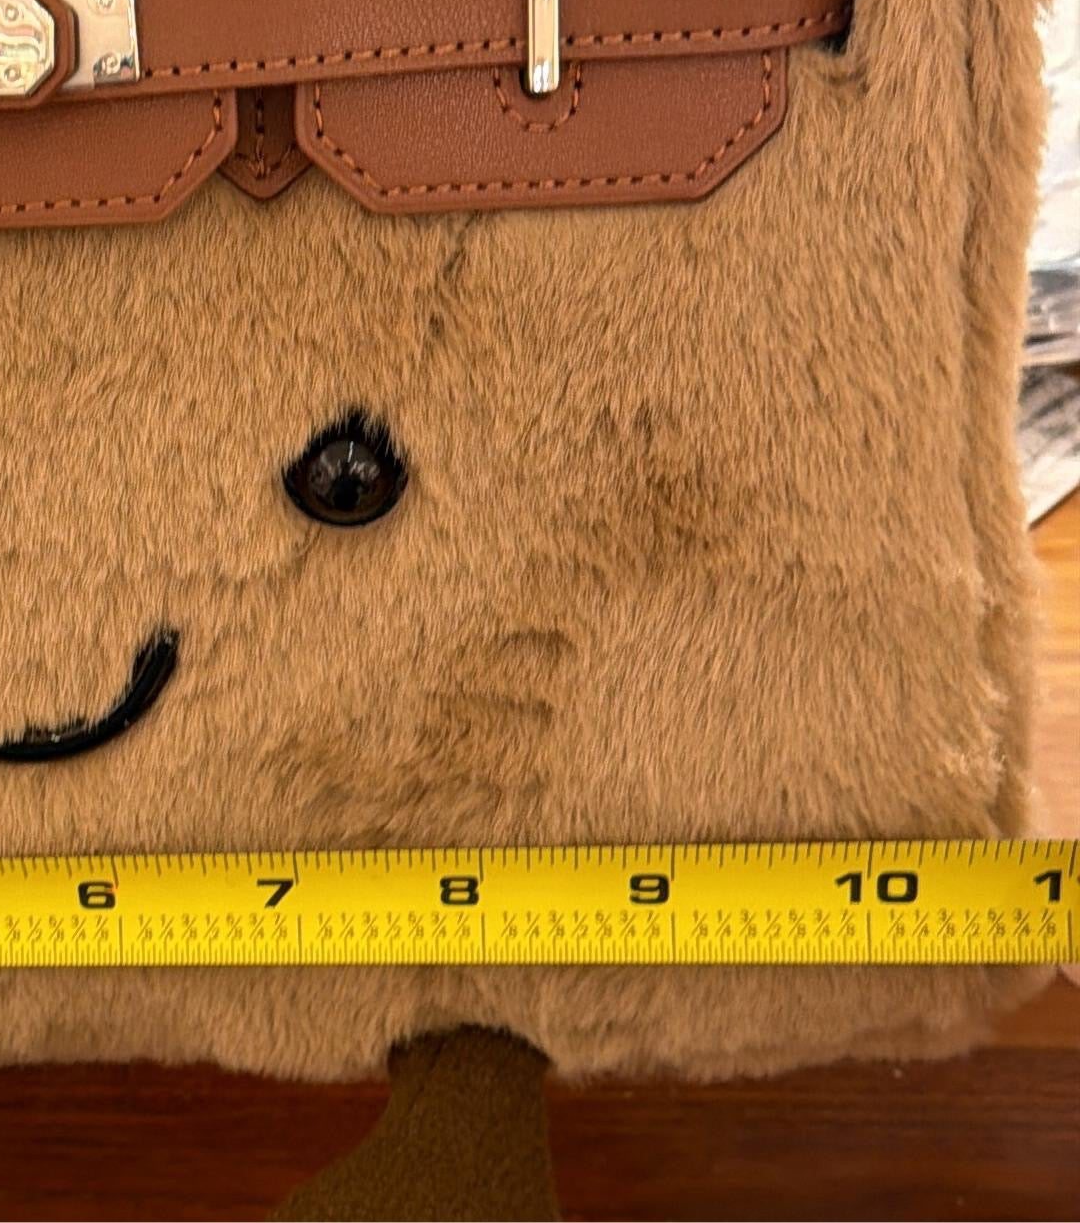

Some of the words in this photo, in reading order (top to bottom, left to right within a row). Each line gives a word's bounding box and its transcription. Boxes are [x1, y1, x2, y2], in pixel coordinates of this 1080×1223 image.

[78, 880, 117, 909] 6
[256, 877, 295, 908] 7
[439, 874, 480, 906] 8
[629, 873, 670, 904] 9
[834, 870, 919, 904] 10
